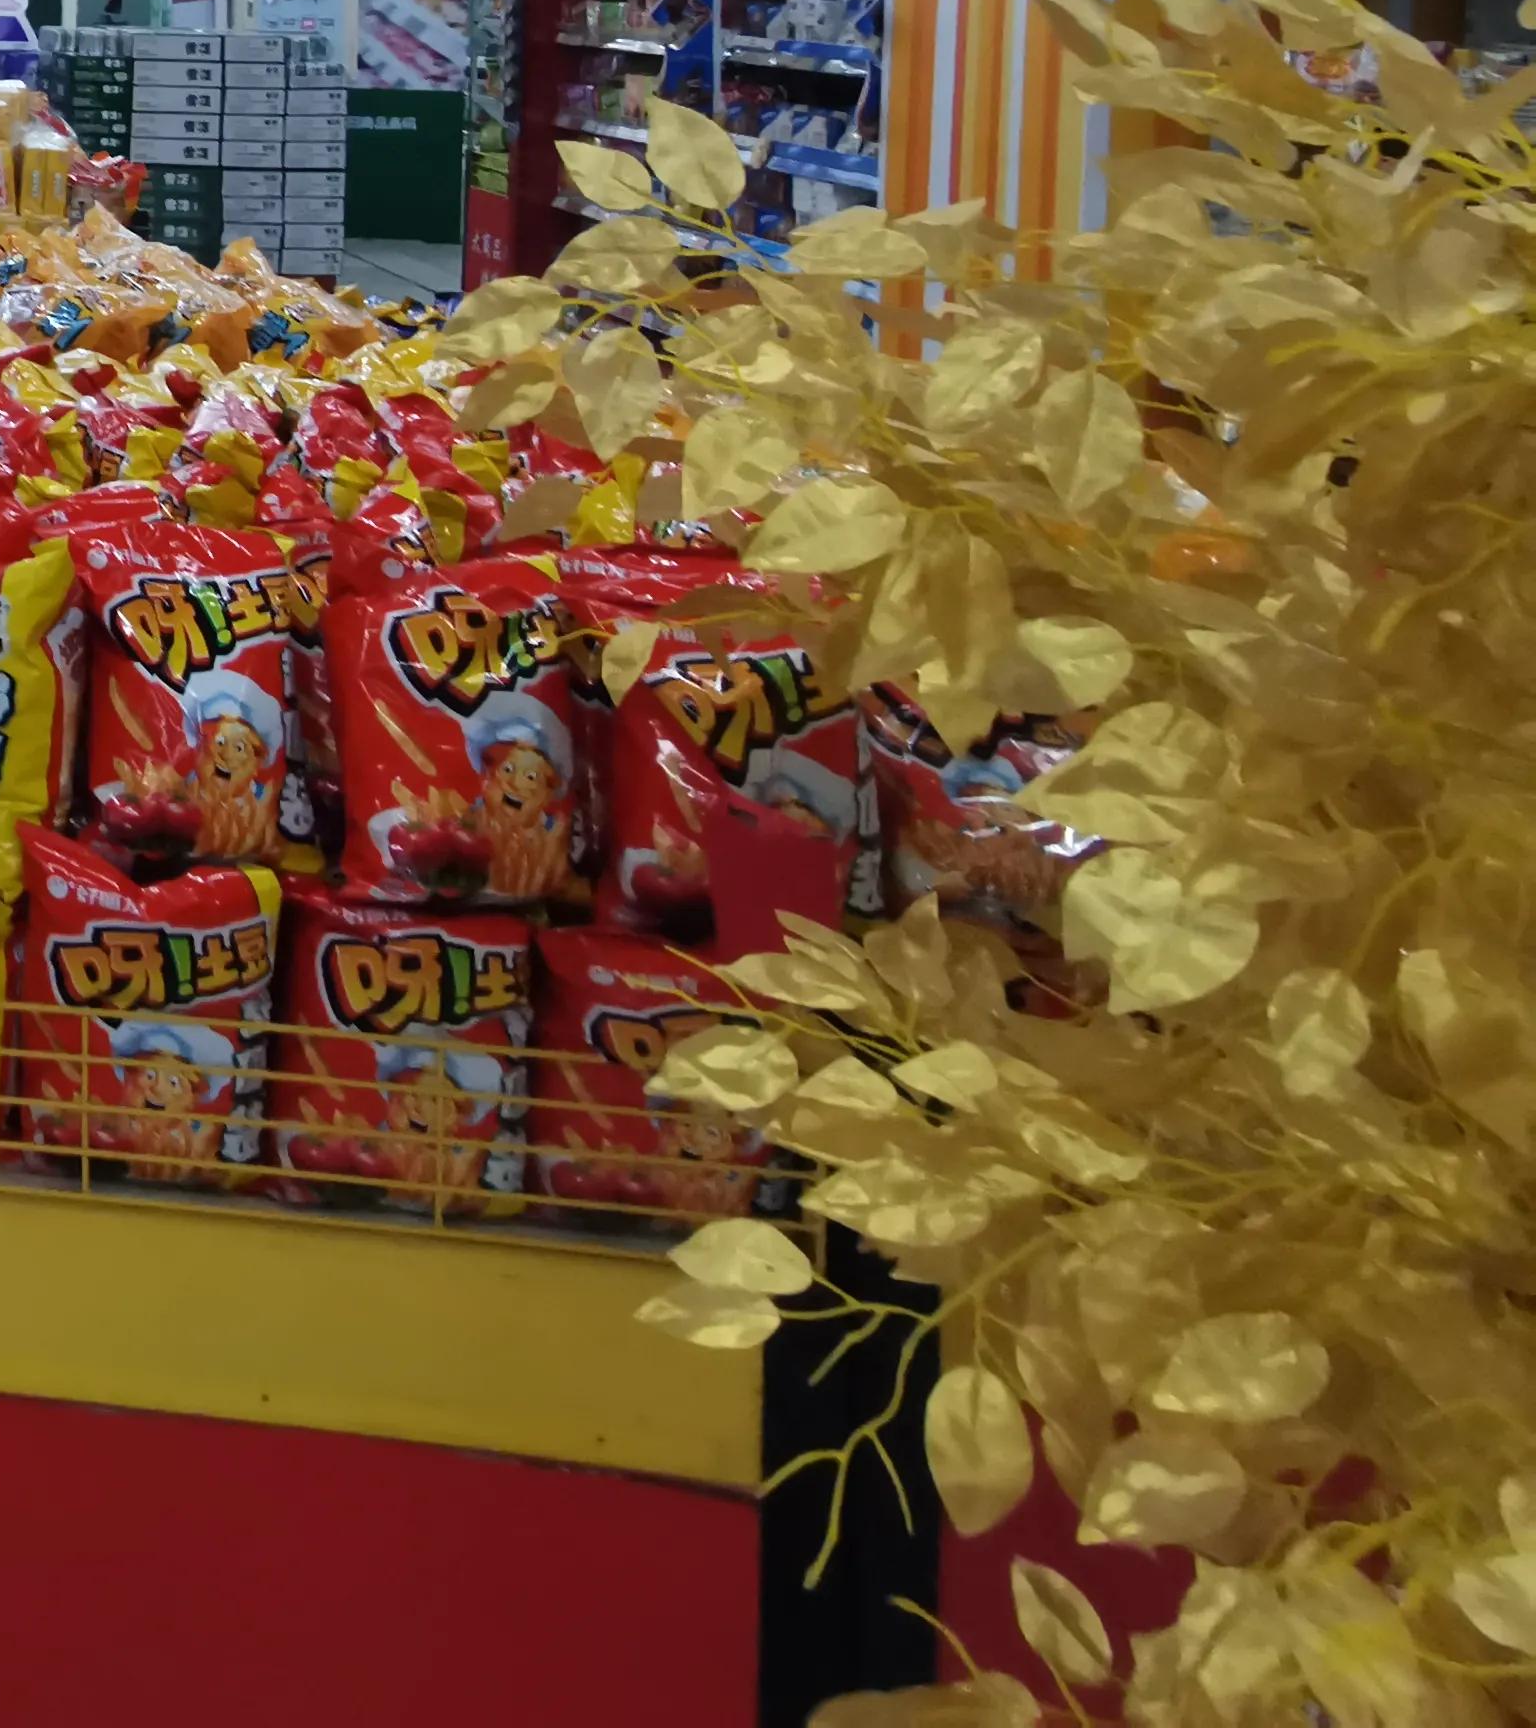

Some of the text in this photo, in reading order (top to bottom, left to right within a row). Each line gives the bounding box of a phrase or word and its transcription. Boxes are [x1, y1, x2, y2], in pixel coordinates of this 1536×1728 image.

[58, 924, 270, 1010] 呀!土豆
[333, 934, 525, 1031] 呀!土
